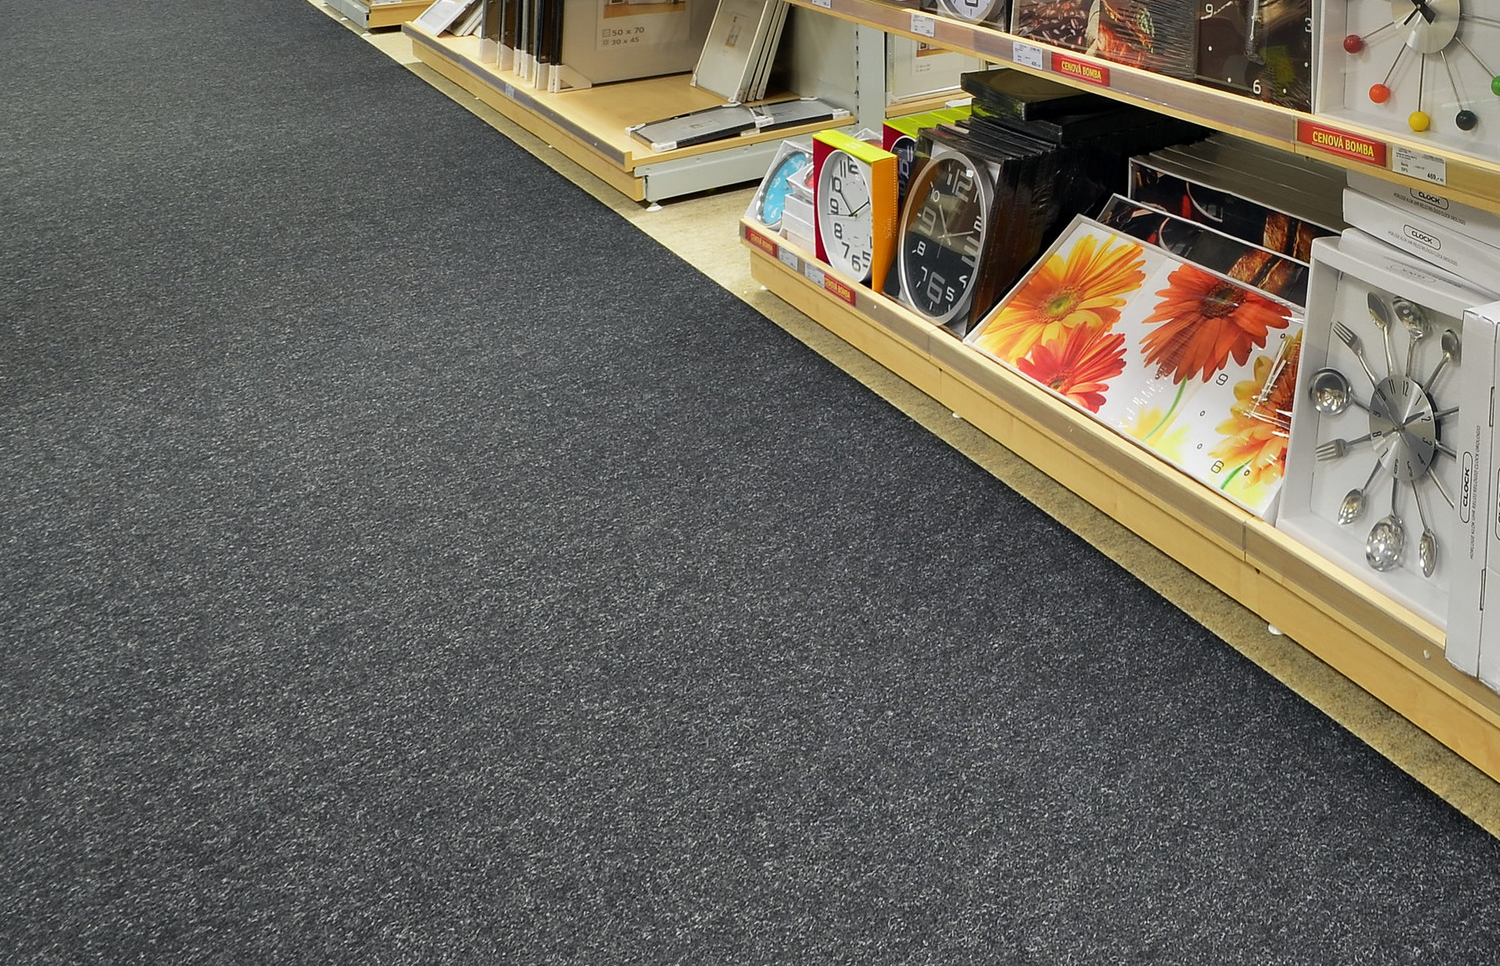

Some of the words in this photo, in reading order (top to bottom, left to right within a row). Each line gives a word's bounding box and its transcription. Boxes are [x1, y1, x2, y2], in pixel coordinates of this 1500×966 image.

[612, 29, 623, 37] 50
[634, 26, 645, 34] 70
[1062, 60, 1081, 75] CENOVÁ
[1083, 66, 1102, 80] BOMBA
[1253, 79, 1261, 94] 6
[1312, 130, 1344, 152] CENOVÁ
[1345, 138, 1374, 157] BOMBA
[1419, 191, 1441, 205] CLOCK
[834, 222, 843, 240] 8
[1411, 230, 1432, 245] CLOCK
[841, 242, 850, 259] 7
[917, 241, 926, 256] 8
[852, 254, 861, 272] 6
